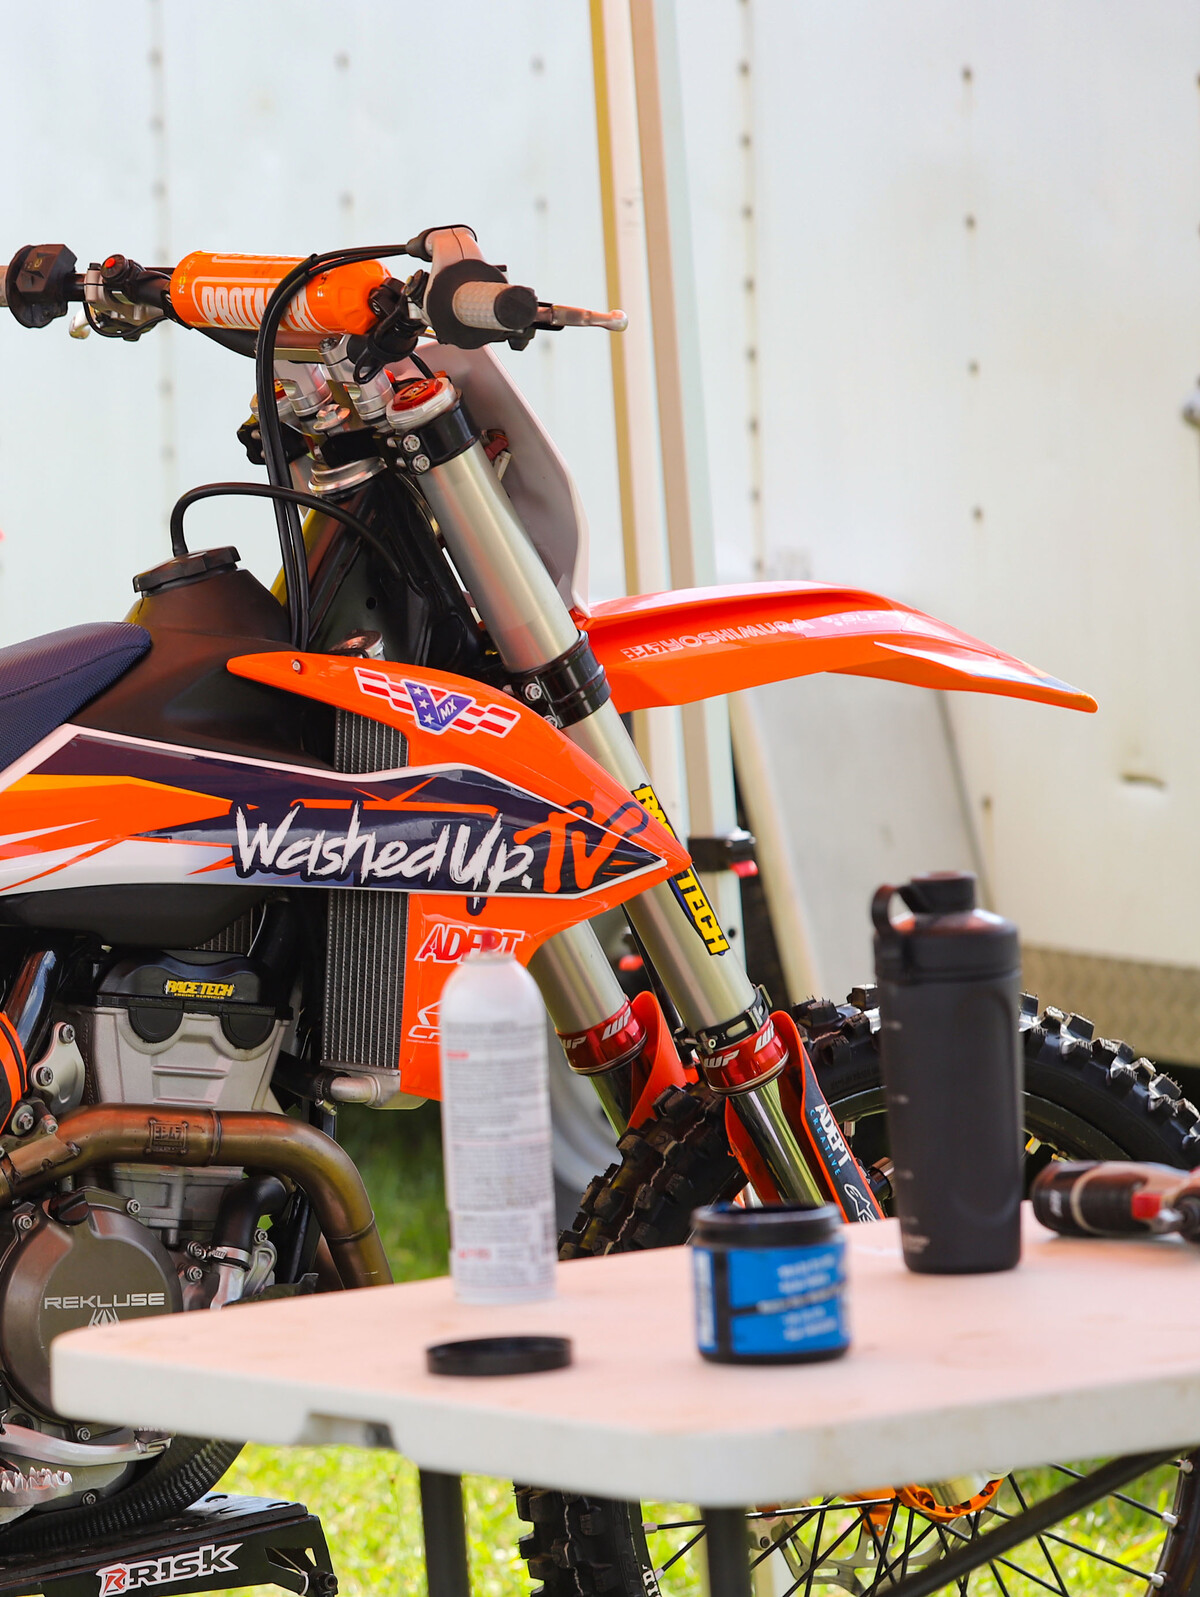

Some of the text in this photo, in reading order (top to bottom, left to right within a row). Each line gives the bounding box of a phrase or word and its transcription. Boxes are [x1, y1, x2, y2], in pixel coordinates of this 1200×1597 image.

[202, 286, 323, 333] PROTAER
[659, 617, 816, 652] YOSHIMURA
[809, 1109, 841, 1176] CREATIVE
[814, 1104, 852, 1168] ADEPT
[43, 1292, 165, 1310] REKLUSE
[127, 1543, 244, 1588] RISK
